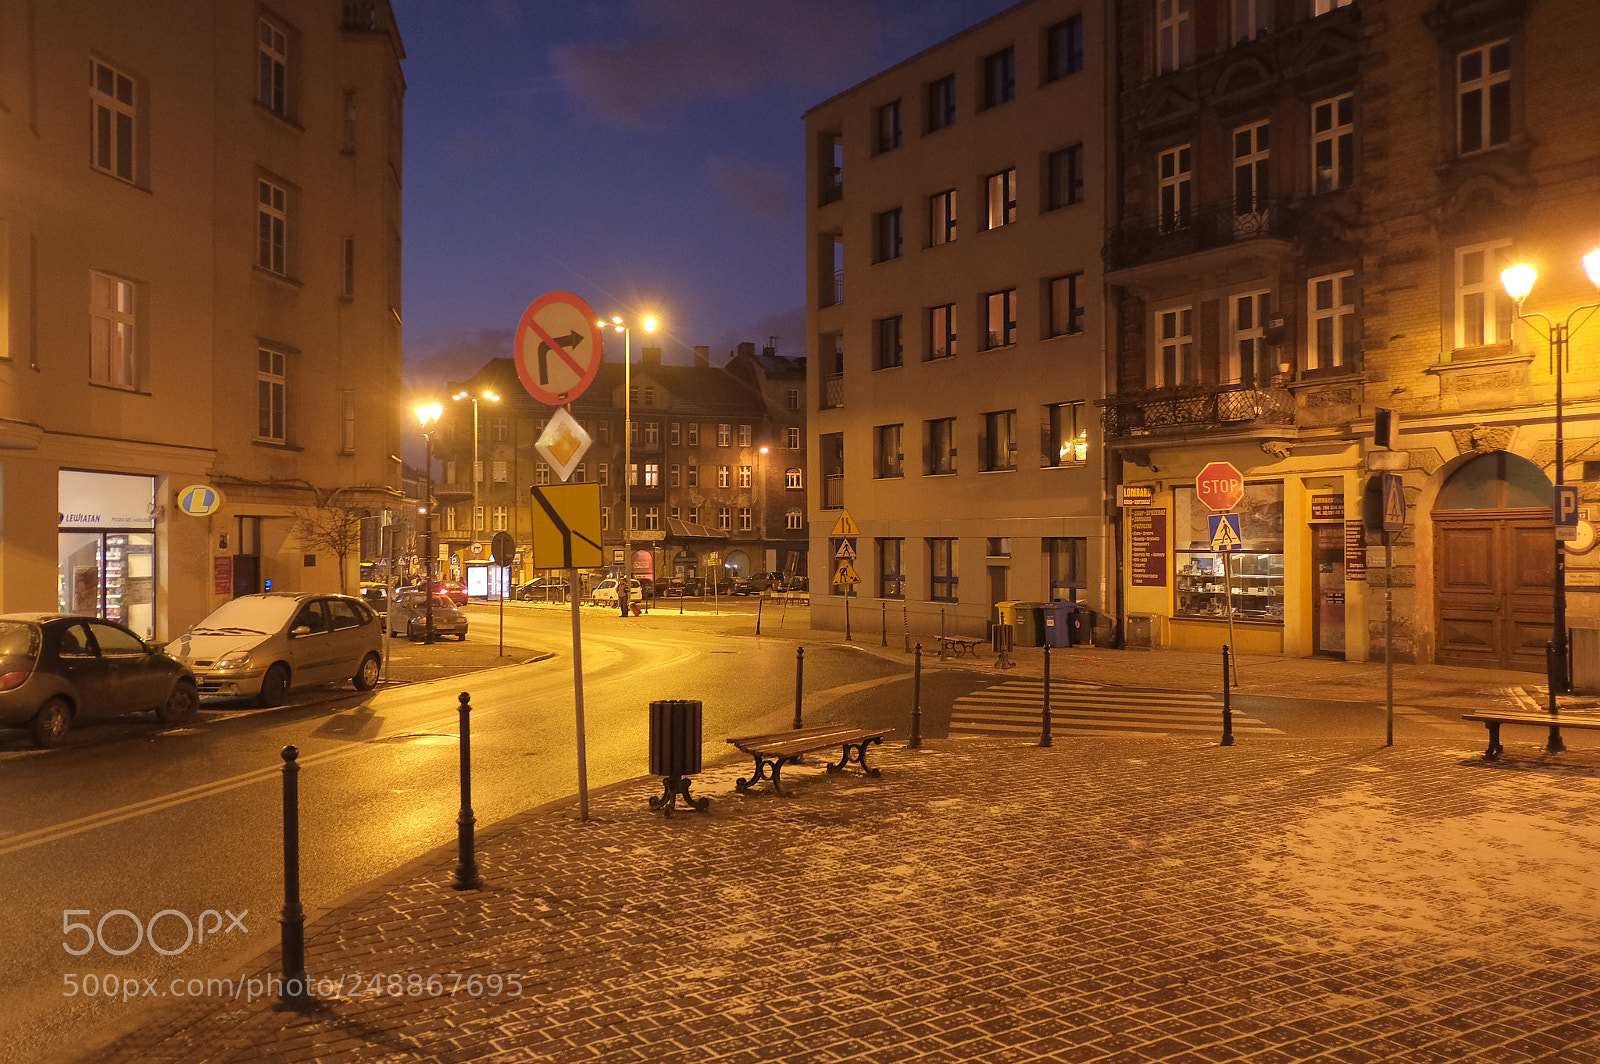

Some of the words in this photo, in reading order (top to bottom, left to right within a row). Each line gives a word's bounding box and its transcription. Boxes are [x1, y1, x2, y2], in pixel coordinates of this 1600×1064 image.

[1203, 479, 1238, 494] STOP
[188, 487, 211, 513] L
[1560, 490, 1575, 522] P
[65, 512, 101, 523] LEWIATAN
